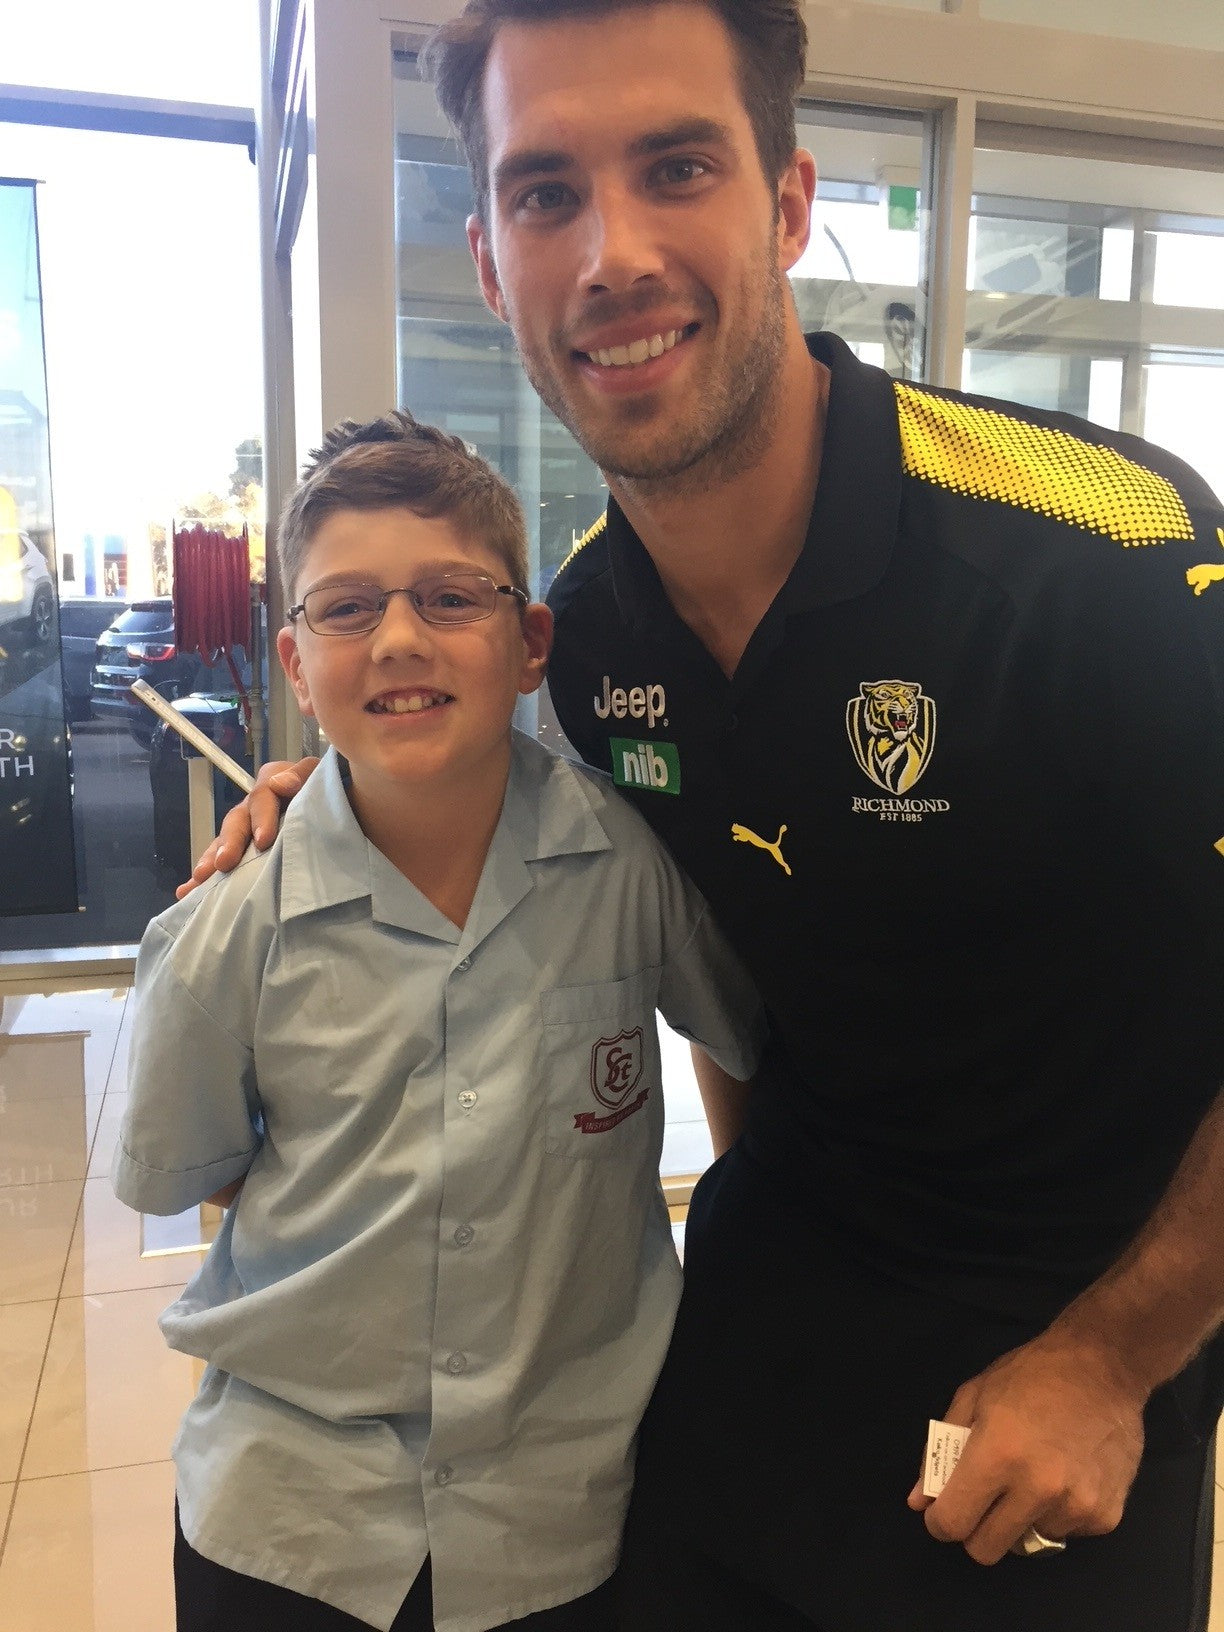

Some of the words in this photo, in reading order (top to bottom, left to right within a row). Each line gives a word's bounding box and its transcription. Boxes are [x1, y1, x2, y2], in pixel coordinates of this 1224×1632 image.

[594, 675, 666, 729] Jeep
[622, 743, 669, 788] nib
[852, 796, 951, 813] RICHMOND
[880, 812, 899, 821] EST
[901, 812, 922, 822] 1885
